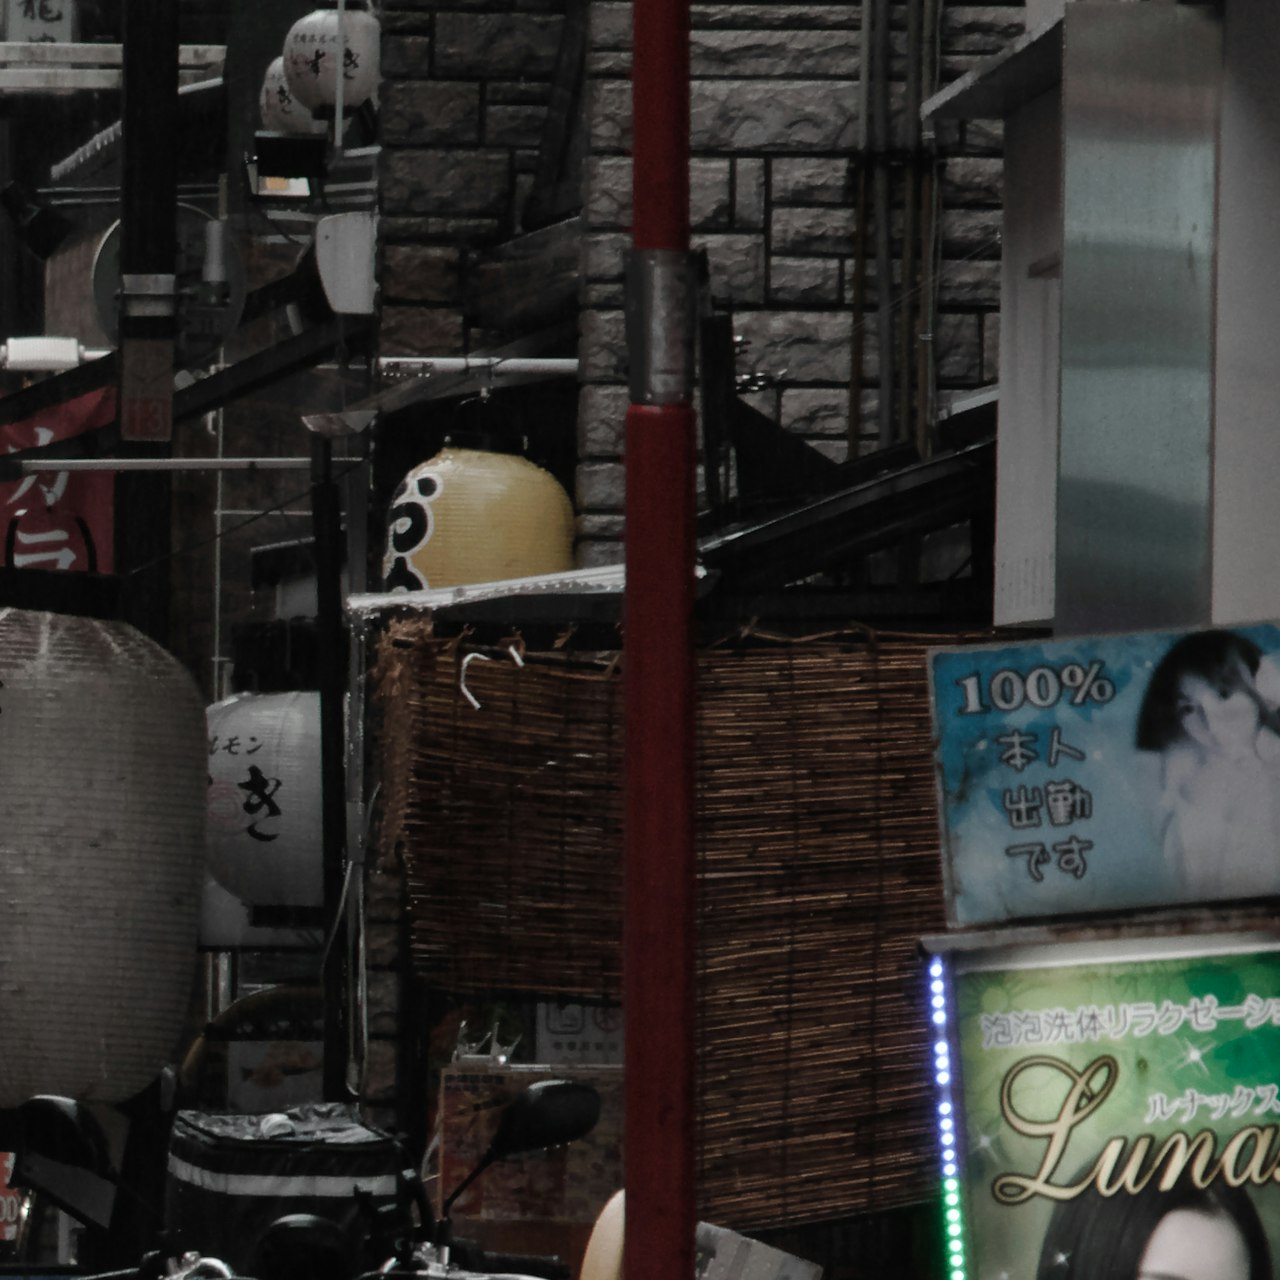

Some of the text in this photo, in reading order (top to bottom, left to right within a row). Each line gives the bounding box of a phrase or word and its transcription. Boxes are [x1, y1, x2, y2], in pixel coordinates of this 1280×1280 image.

[955, 660, 1117, 715] 100%
[996, 727, 1085, 770] 本人
[1003, 780, 1093, 830] 出勤
[1005, 836, 1094, 882] です
[992, 1054, 1280, 1206] Luna
